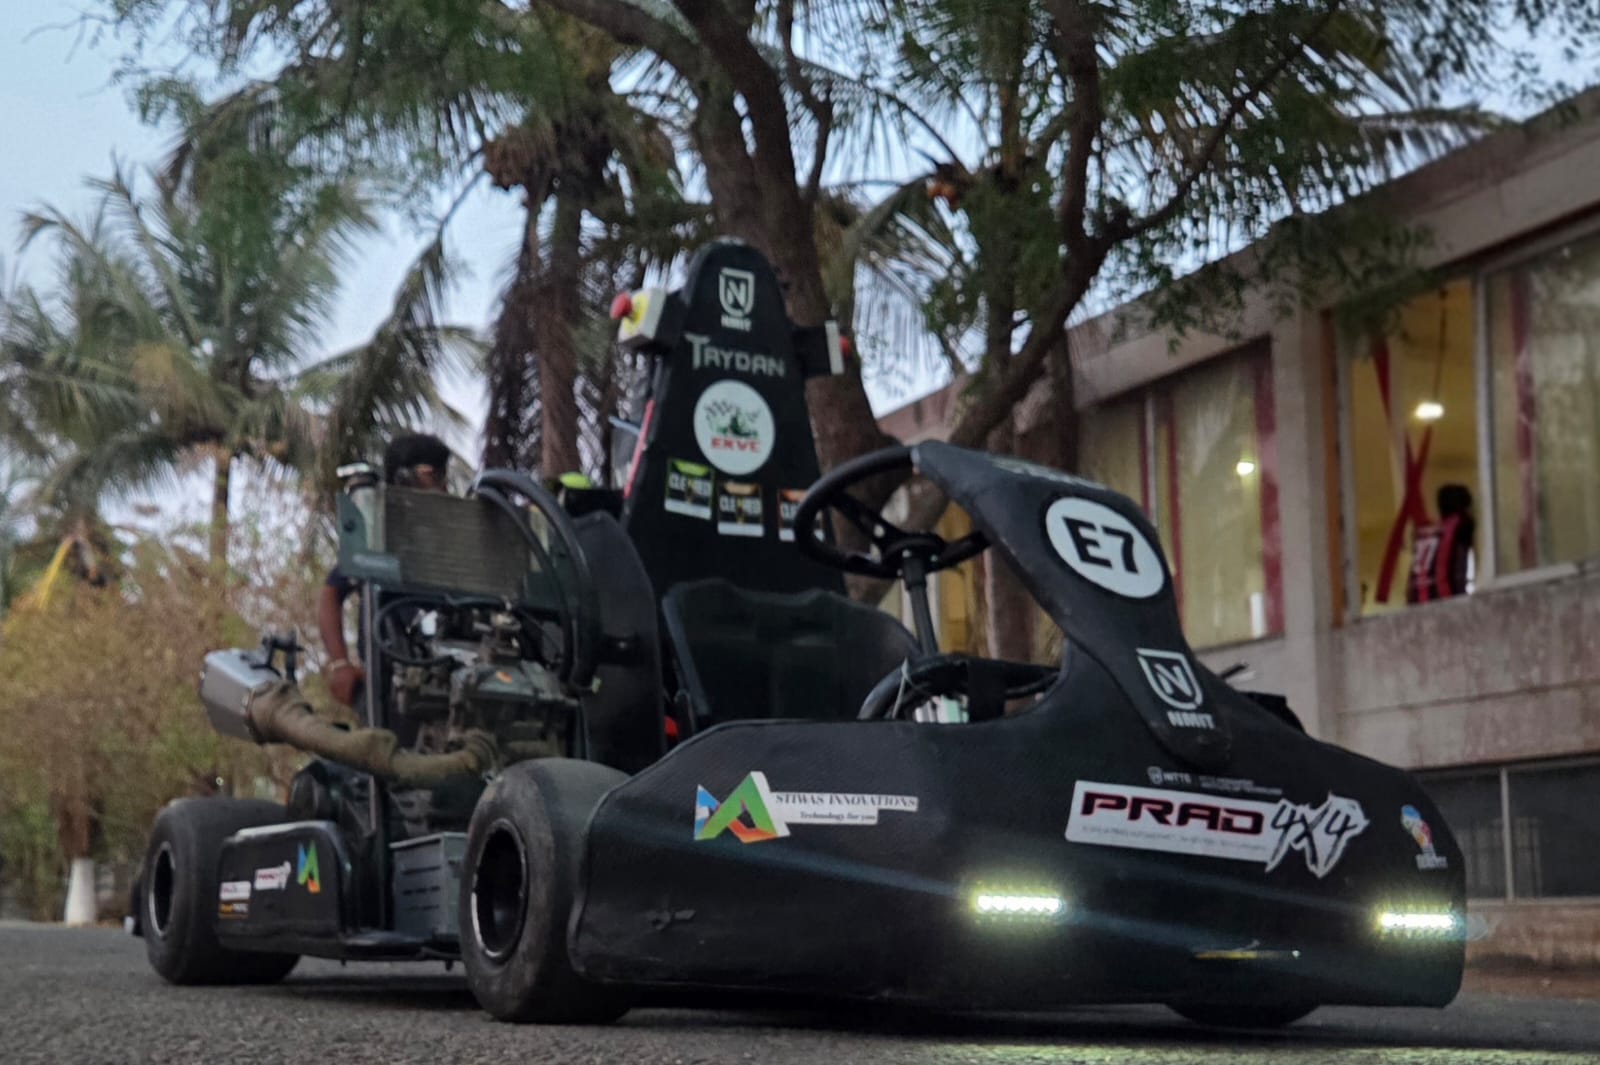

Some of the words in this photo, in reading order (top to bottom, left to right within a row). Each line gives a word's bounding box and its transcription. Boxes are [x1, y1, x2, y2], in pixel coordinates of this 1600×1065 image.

[1062, 516, 1139, 574] E7
[829, 795, 916, 808] INNOVATIONS
[1080, 791, 1265, 835] PRAD
